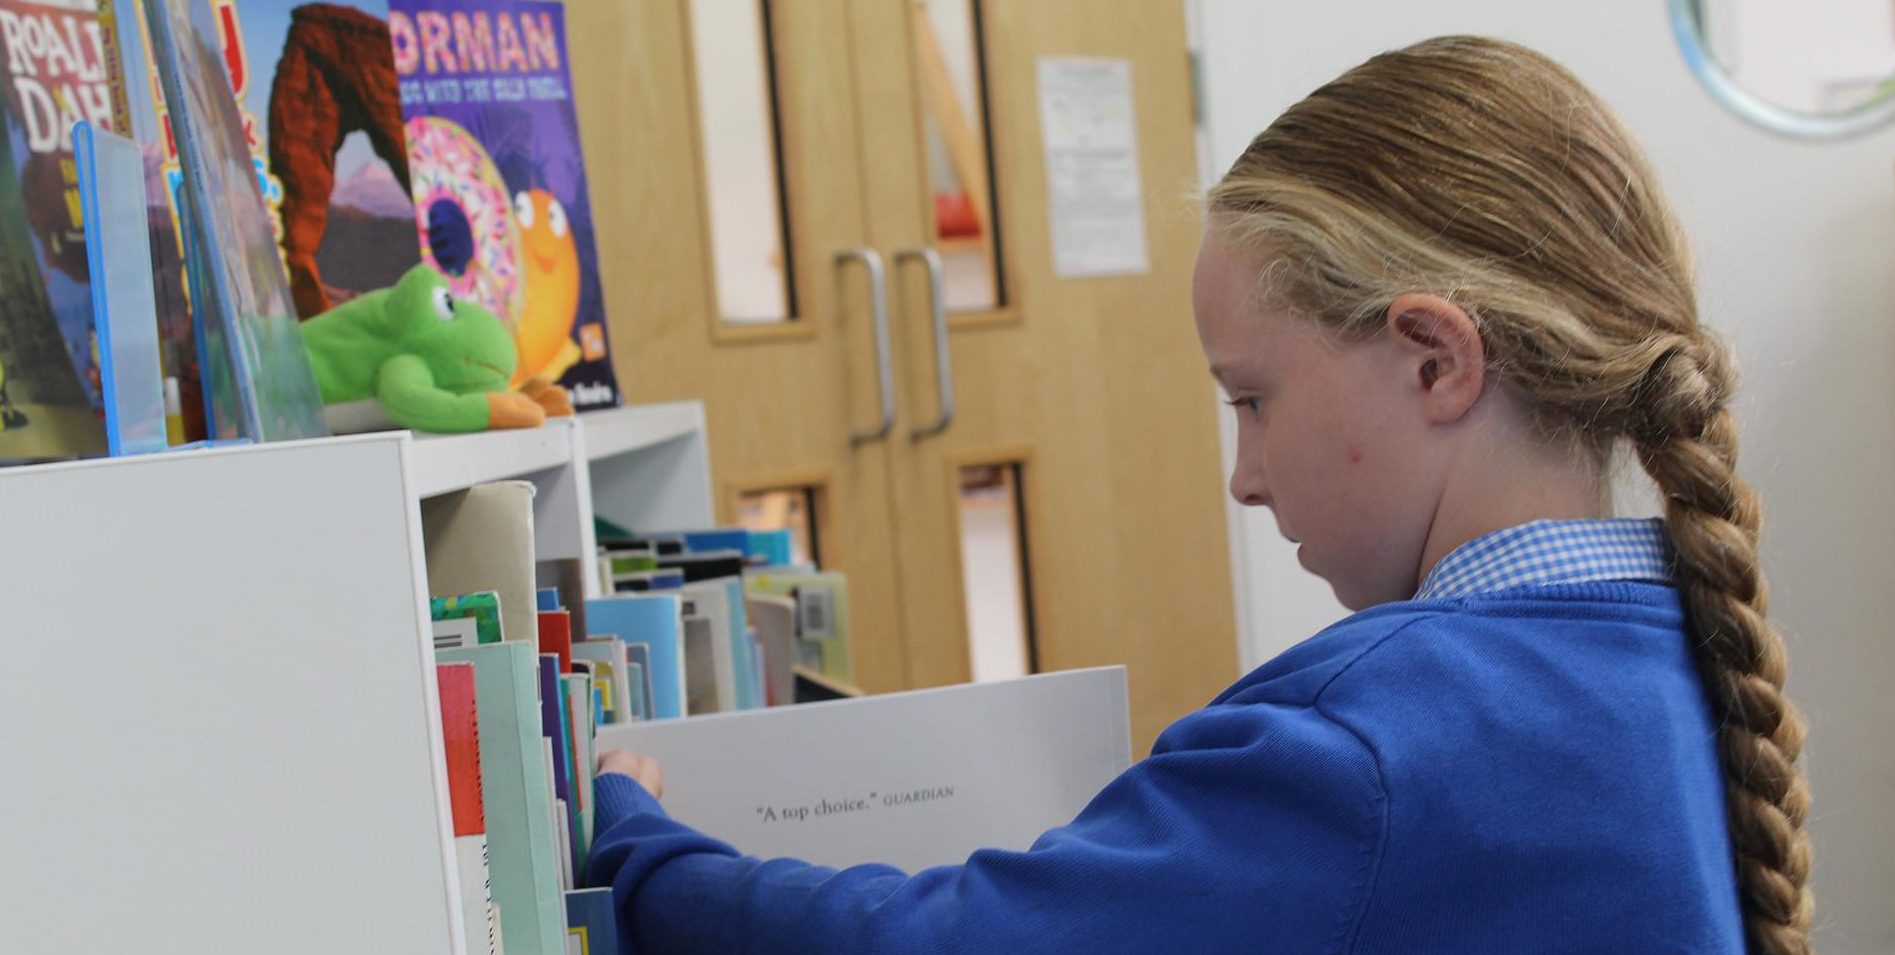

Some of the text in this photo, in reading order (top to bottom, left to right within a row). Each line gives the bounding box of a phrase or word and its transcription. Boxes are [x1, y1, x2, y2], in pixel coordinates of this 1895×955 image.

[389, 10, 559, 75] ORMAN
[14, 76, 114, 153] DAH
[782, 805, 809, 822] top
[883, 785, 954, 807] GUARDIAN
